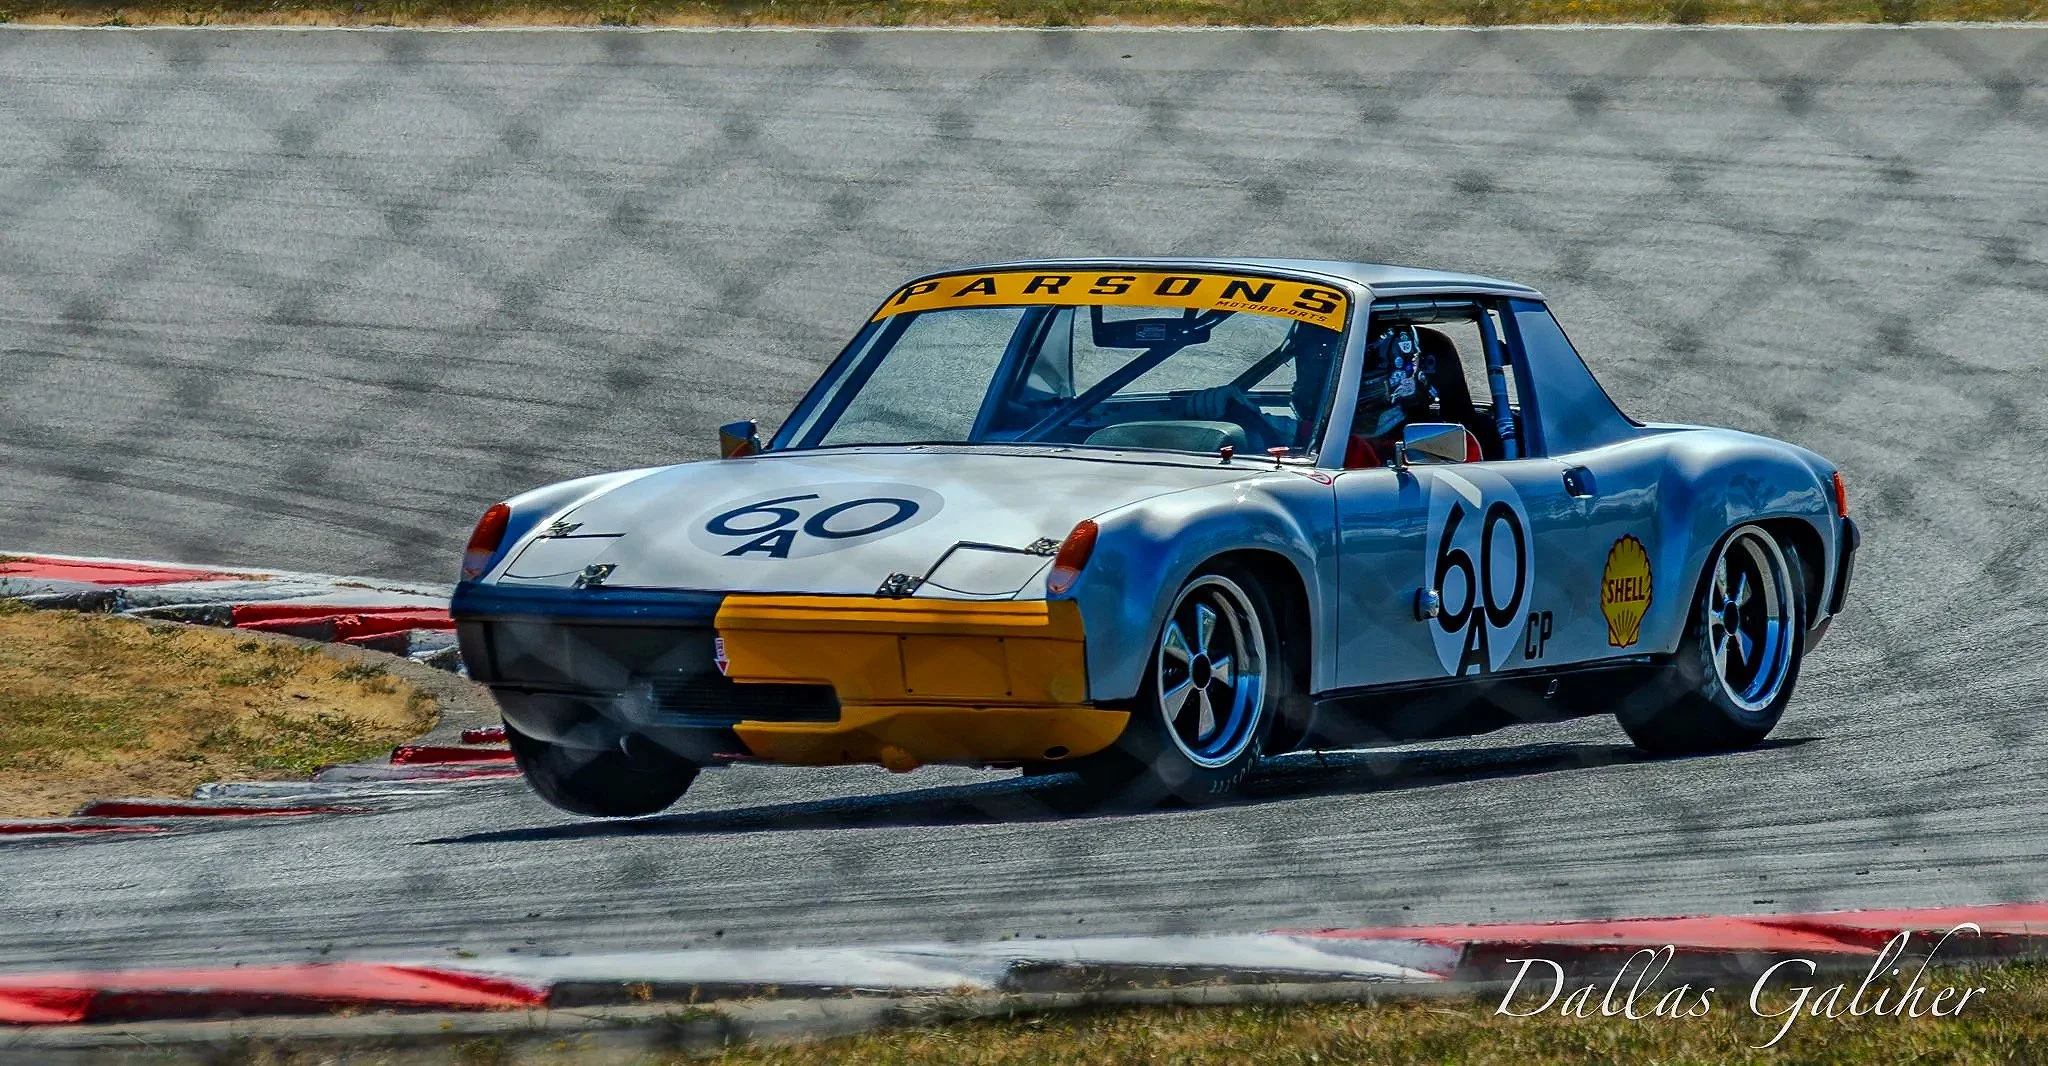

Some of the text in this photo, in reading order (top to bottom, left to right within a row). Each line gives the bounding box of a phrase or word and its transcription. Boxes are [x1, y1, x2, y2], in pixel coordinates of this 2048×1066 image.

[894, 275, 1343, 314] PARSONS
[1215, 301, 1328, 323] MOTORSPORTS
[705, 493, 920, 539] 60
[721, 529, 798, 559] A
[1434, 500, 1526, 633] 60
[1607, 576, 1646, 604] SHELL
[1456, 606, 1491, 678] A
[1524, 610, 1553, 661] CP
